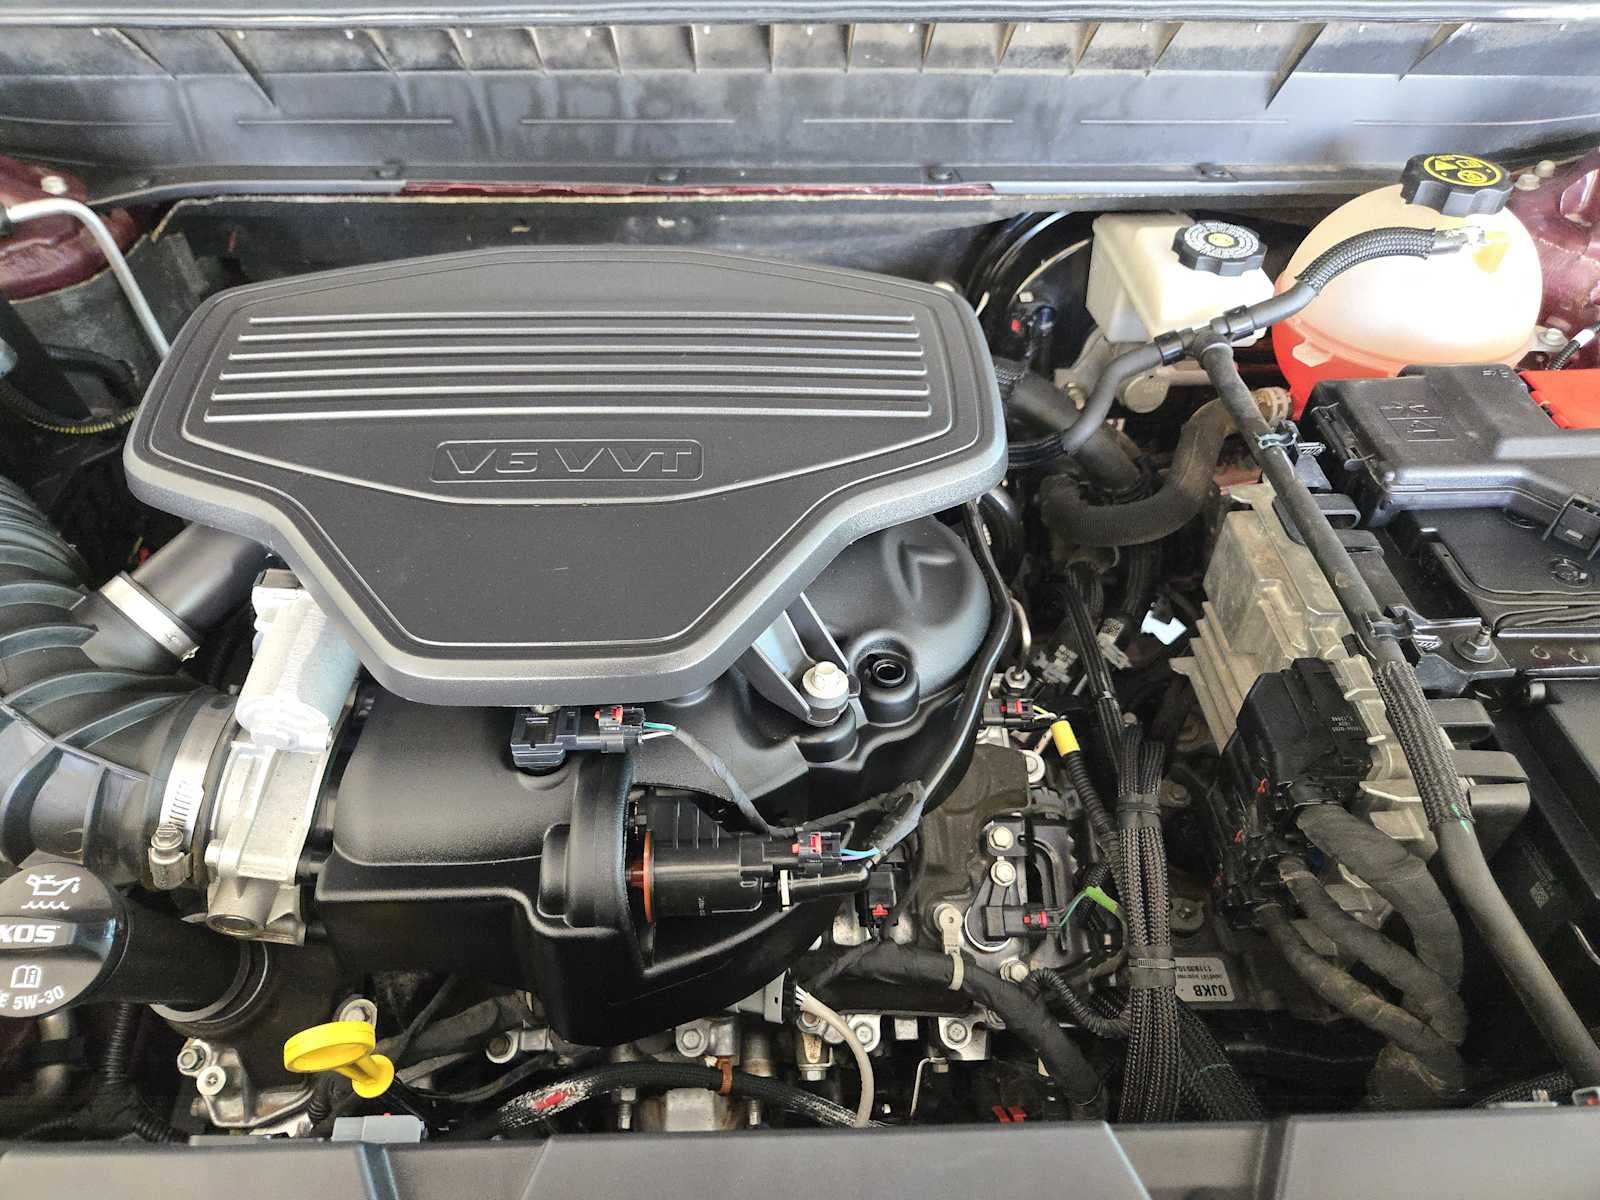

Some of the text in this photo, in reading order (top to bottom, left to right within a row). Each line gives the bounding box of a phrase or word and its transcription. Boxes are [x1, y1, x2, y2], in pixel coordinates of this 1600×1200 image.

[446, 447, 693, 474] V6 VVT
[12, 985, 65, 1010] 5W-30
